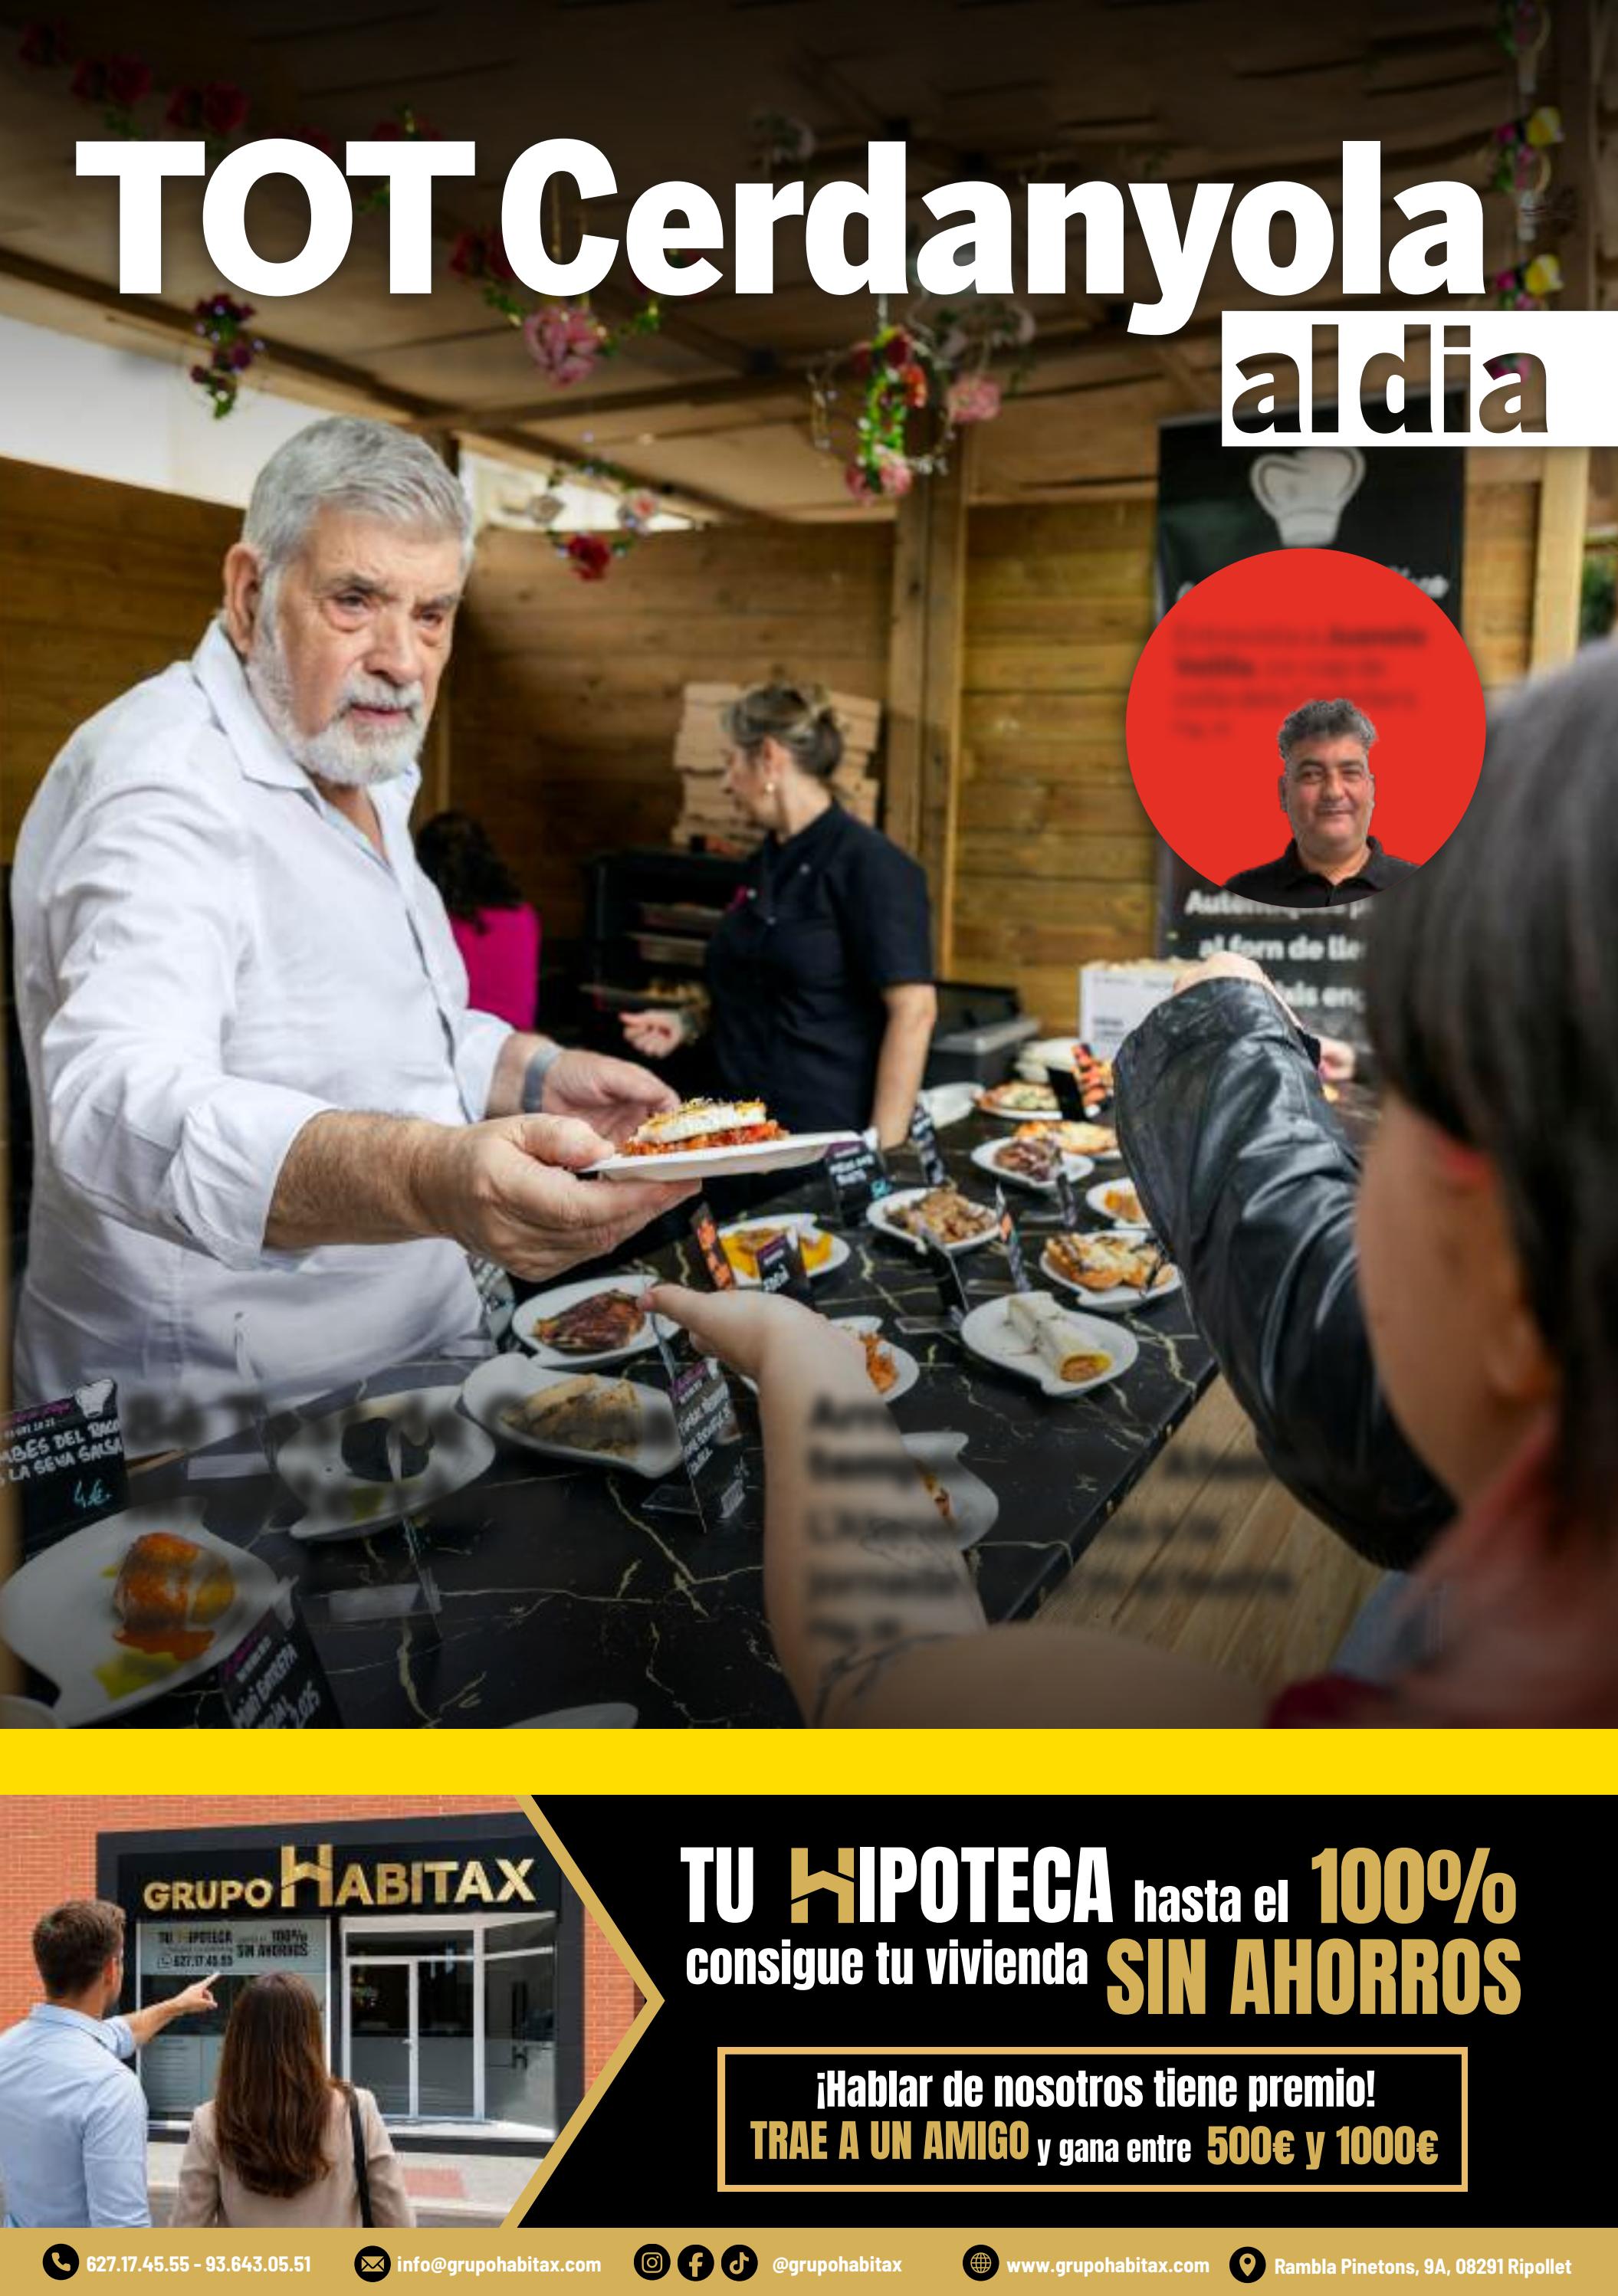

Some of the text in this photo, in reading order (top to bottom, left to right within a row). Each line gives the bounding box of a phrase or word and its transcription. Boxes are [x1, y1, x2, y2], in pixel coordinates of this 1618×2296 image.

[1288, 934, 1325, 960] de
[53, 1430, 86, 1448] DEL
[8, 1465, 31, 1481] LA
[34, 1451, 76, 1474] SEVA
[78, 1437, 123, 1462] SALSA
[143, 1843, 537, 1911] GRUPO HABITAX
